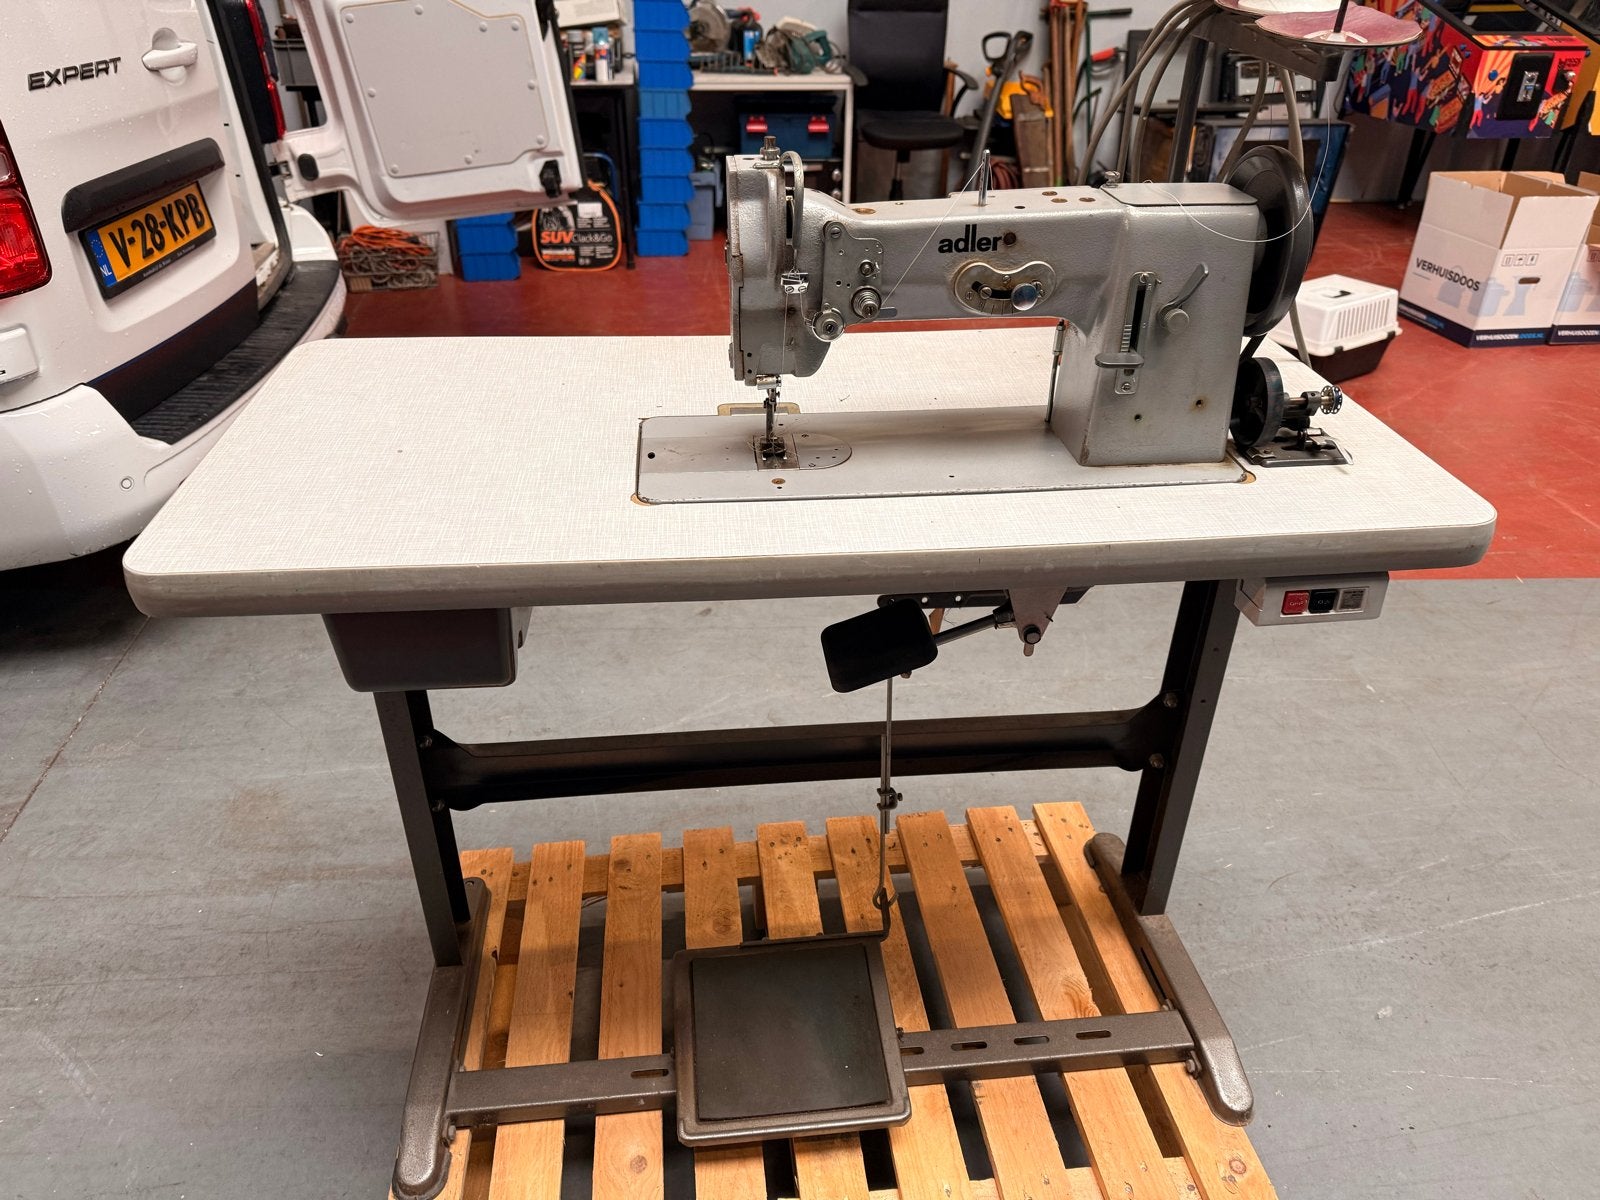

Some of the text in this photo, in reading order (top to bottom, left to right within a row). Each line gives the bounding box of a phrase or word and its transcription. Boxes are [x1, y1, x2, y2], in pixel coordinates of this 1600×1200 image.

[27, 56, 121, 91] EXPERT
[108, 193, 205, 269] V-28-KPB
[541, 230, 575, 244] SUV
[938, 223, 1002, 253] adler
[100, 264, 113, 277] NL
[1415, 257, 1481, 291] VERHUISDOOS
